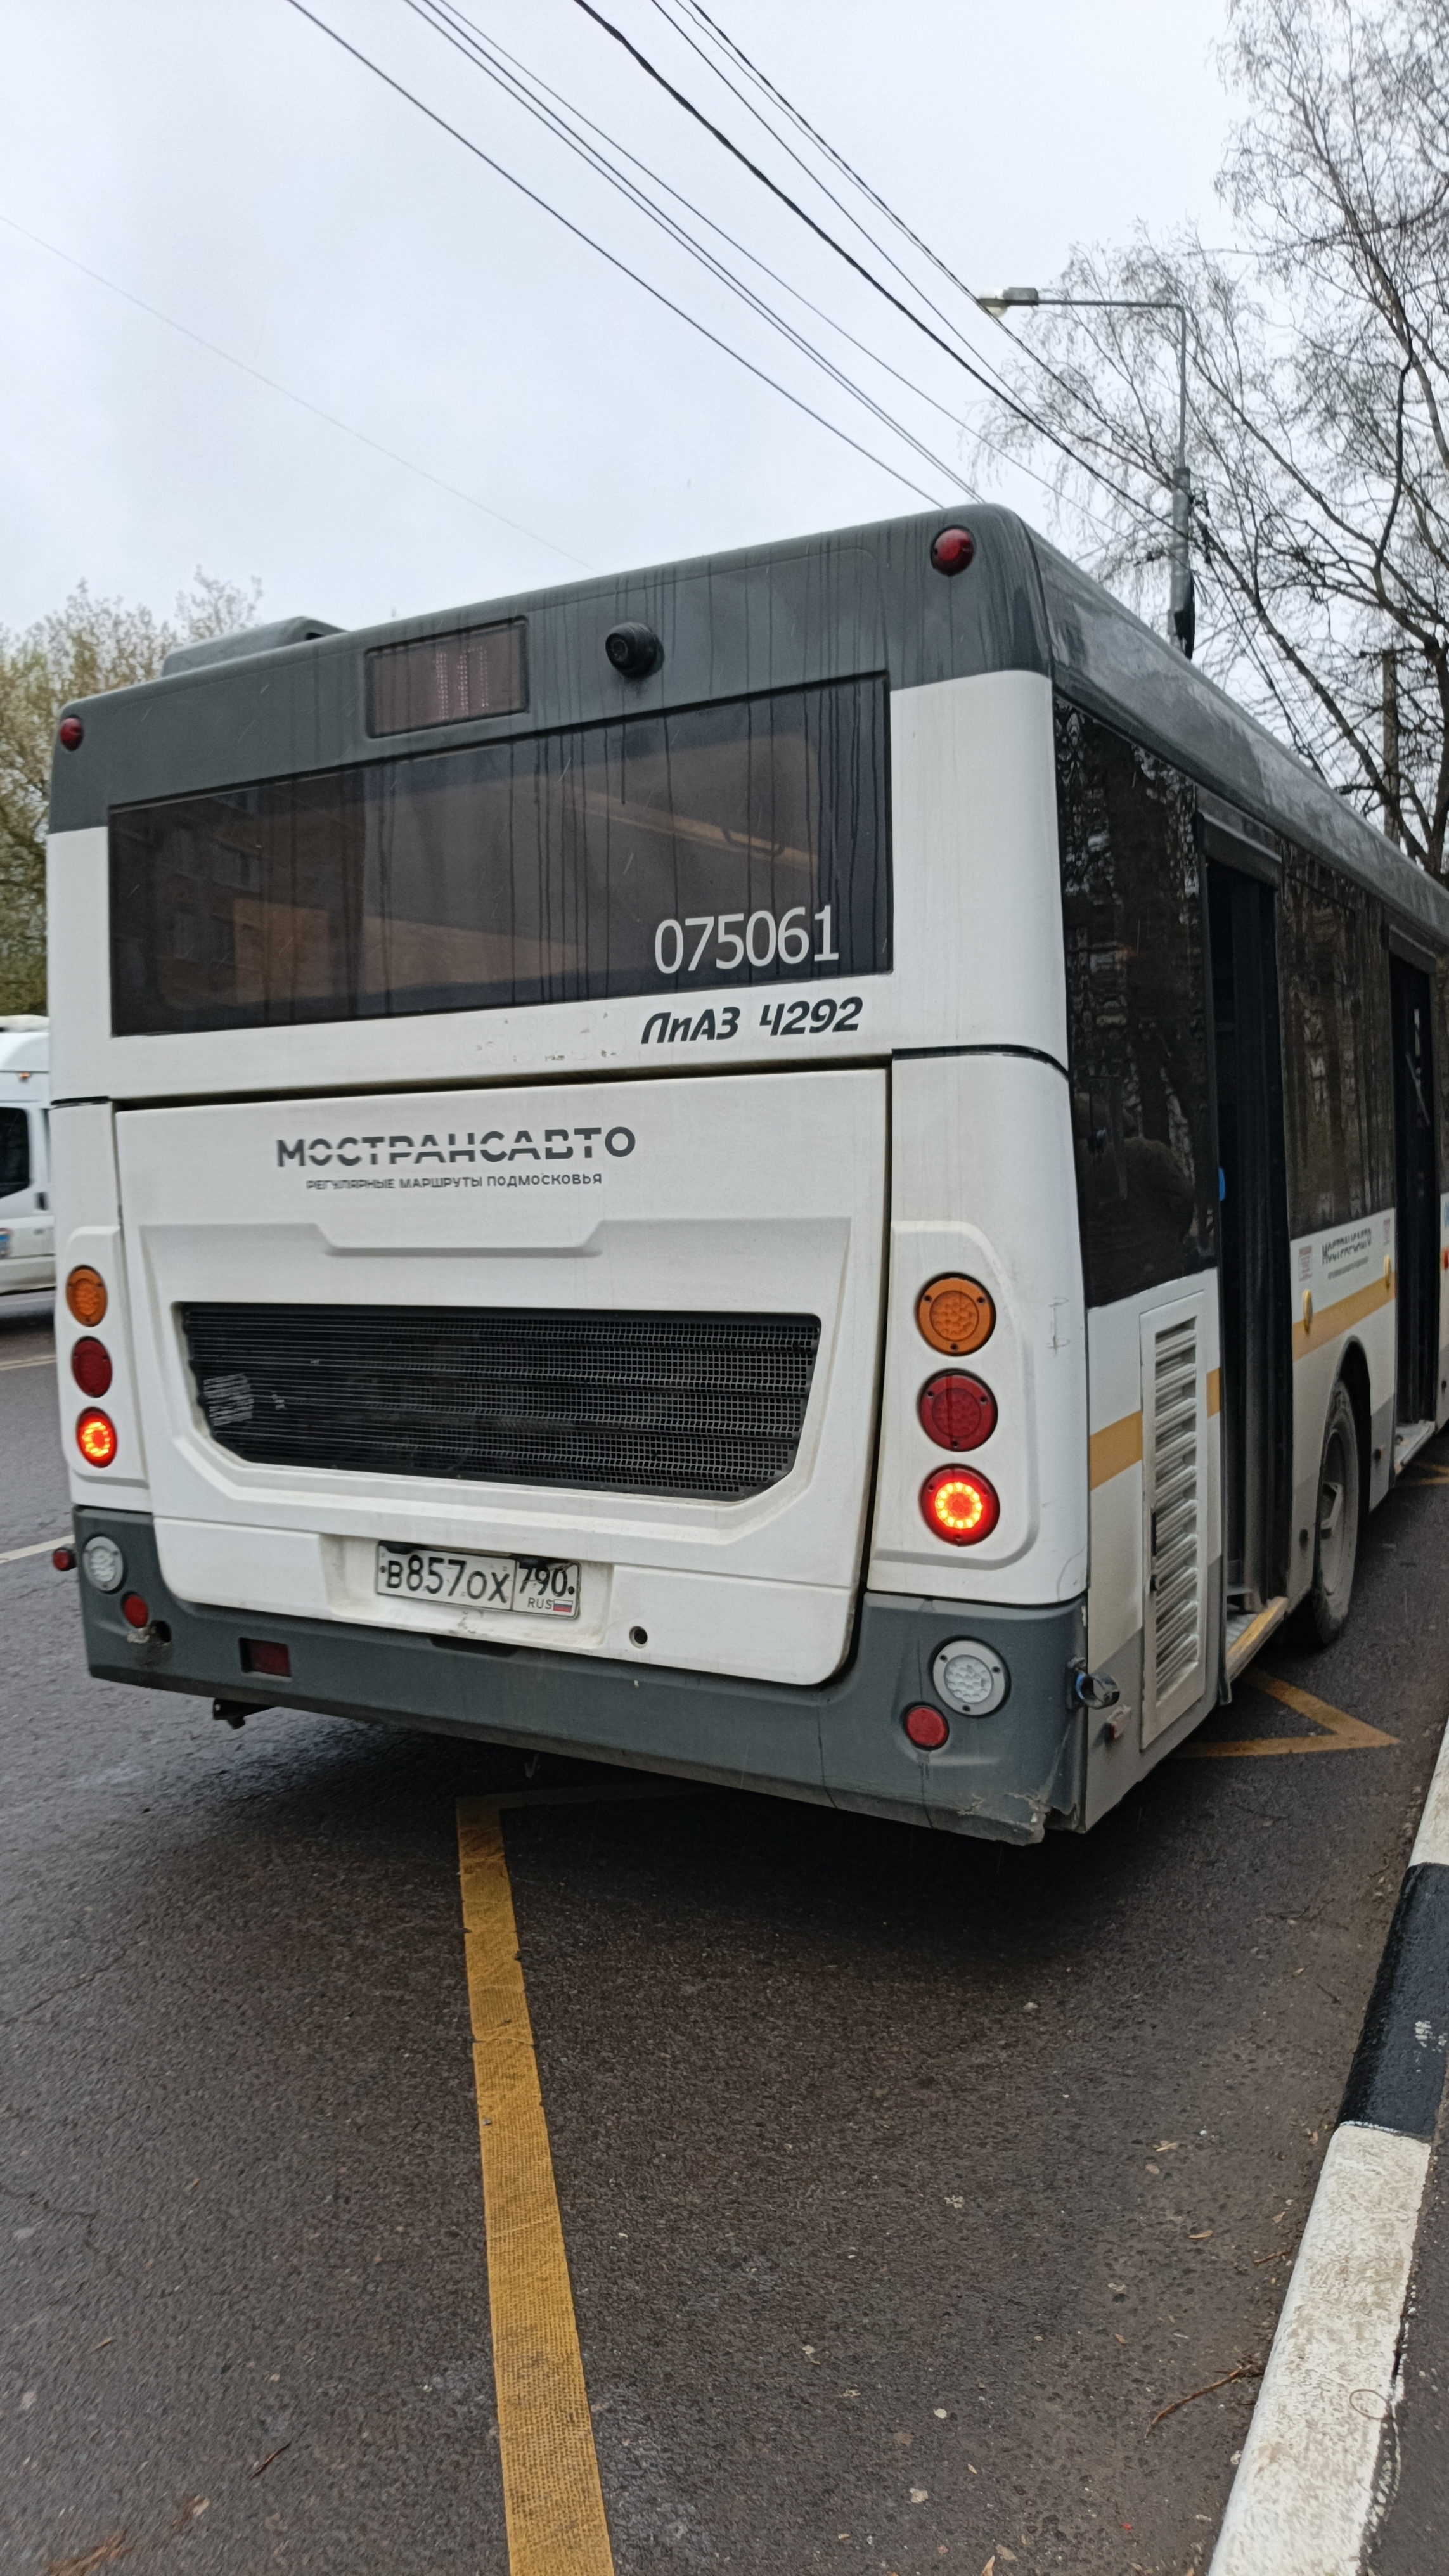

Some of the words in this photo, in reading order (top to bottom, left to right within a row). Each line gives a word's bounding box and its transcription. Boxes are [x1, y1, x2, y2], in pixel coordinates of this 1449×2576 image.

[655, 905, 839, 974] 075061
[641, 1007, 740, 1044] ЛиАЗ
[759, 997, 863, 1036] 4292
[276, 1126, 636, 1167] МОСТРАНСАВТО
[306, 1179, 395, 1190] РЕГУЛЯРНЫЕ
[399, 1176, 482, 1188] МАРШРУТЫ
[487, 1173, 602, 1188] ПОДМОСКОВЬЯ
[527, 1597, 552, 1609] RUS
